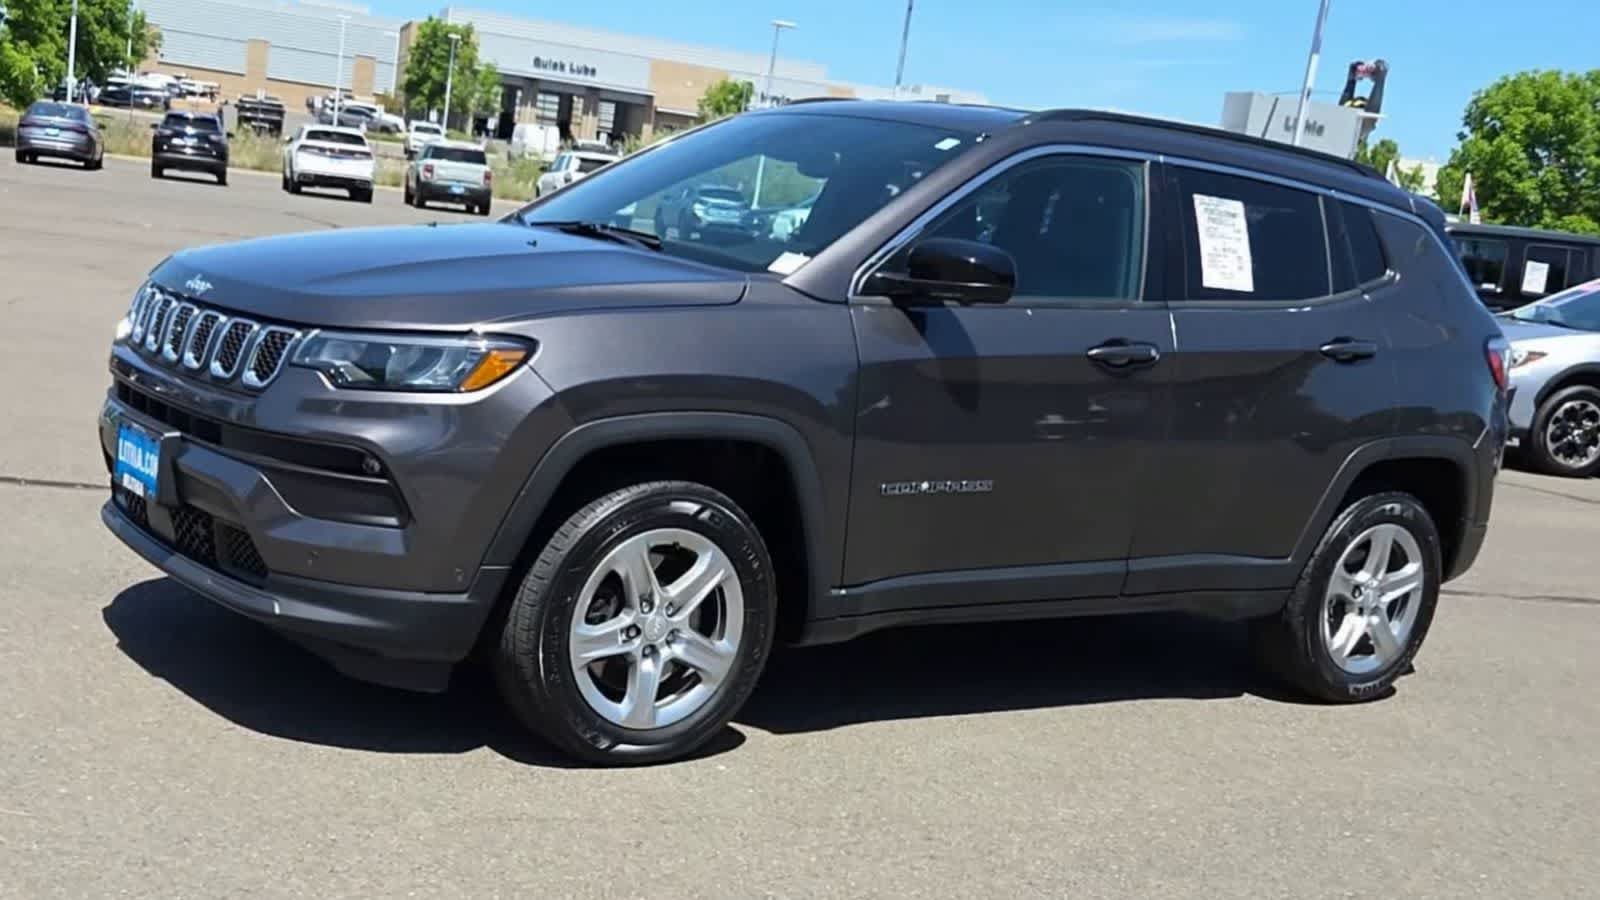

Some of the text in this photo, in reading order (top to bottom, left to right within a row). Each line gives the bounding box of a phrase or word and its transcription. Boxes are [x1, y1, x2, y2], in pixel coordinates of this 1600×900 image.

[533, 56, 597, 78] Quick Lube
[880, 480, 993, 496] COMPASS
